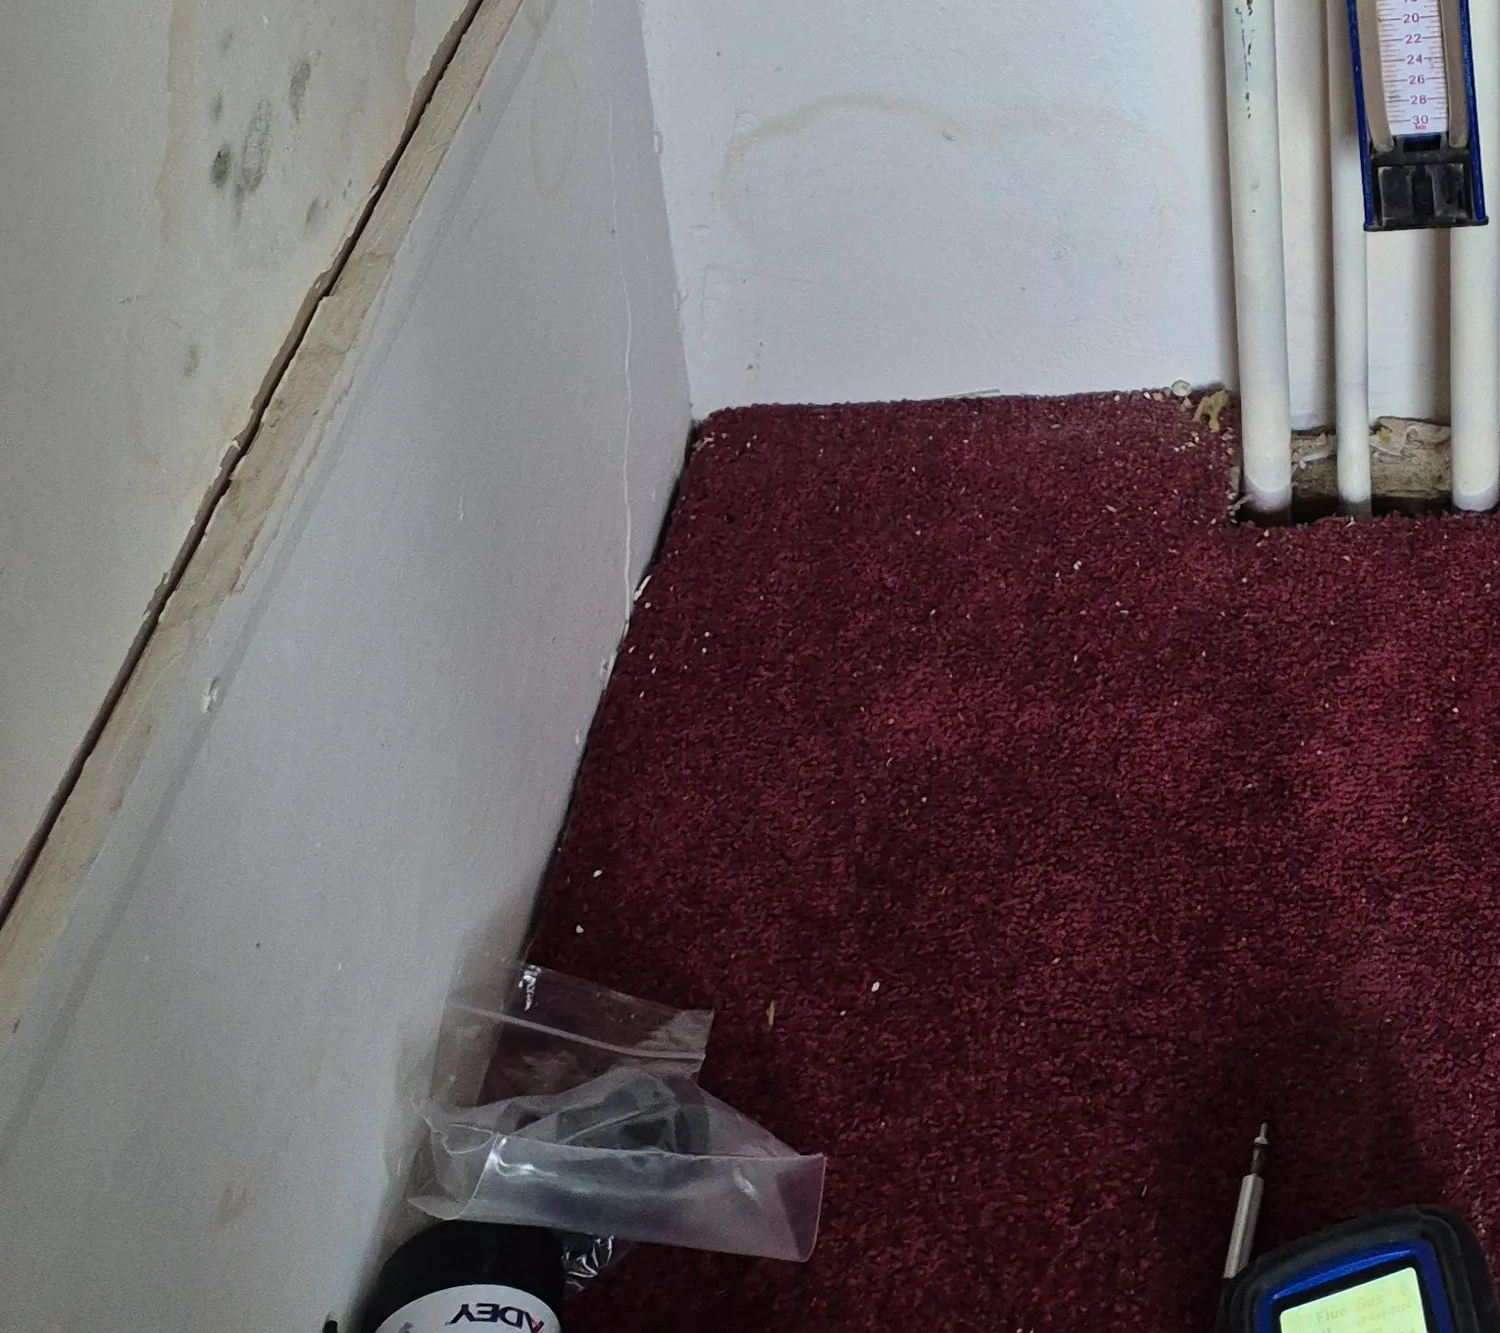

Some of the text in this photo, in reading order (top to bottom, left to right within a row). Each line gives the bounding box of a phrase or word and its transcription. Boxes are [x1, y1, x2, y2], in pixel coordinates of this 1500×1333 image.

[1403, 13, 1420, 23] 20
[1405, 33, 1422, 44] 22
[1406, 54, 1422, 65] 24
[1408, 75, 1425, 85] 26
[1410, 95, 1426, 105] 28
[1412, 115, 1428, 125] 30
[450, 1302, 545, 1333] ADEY
